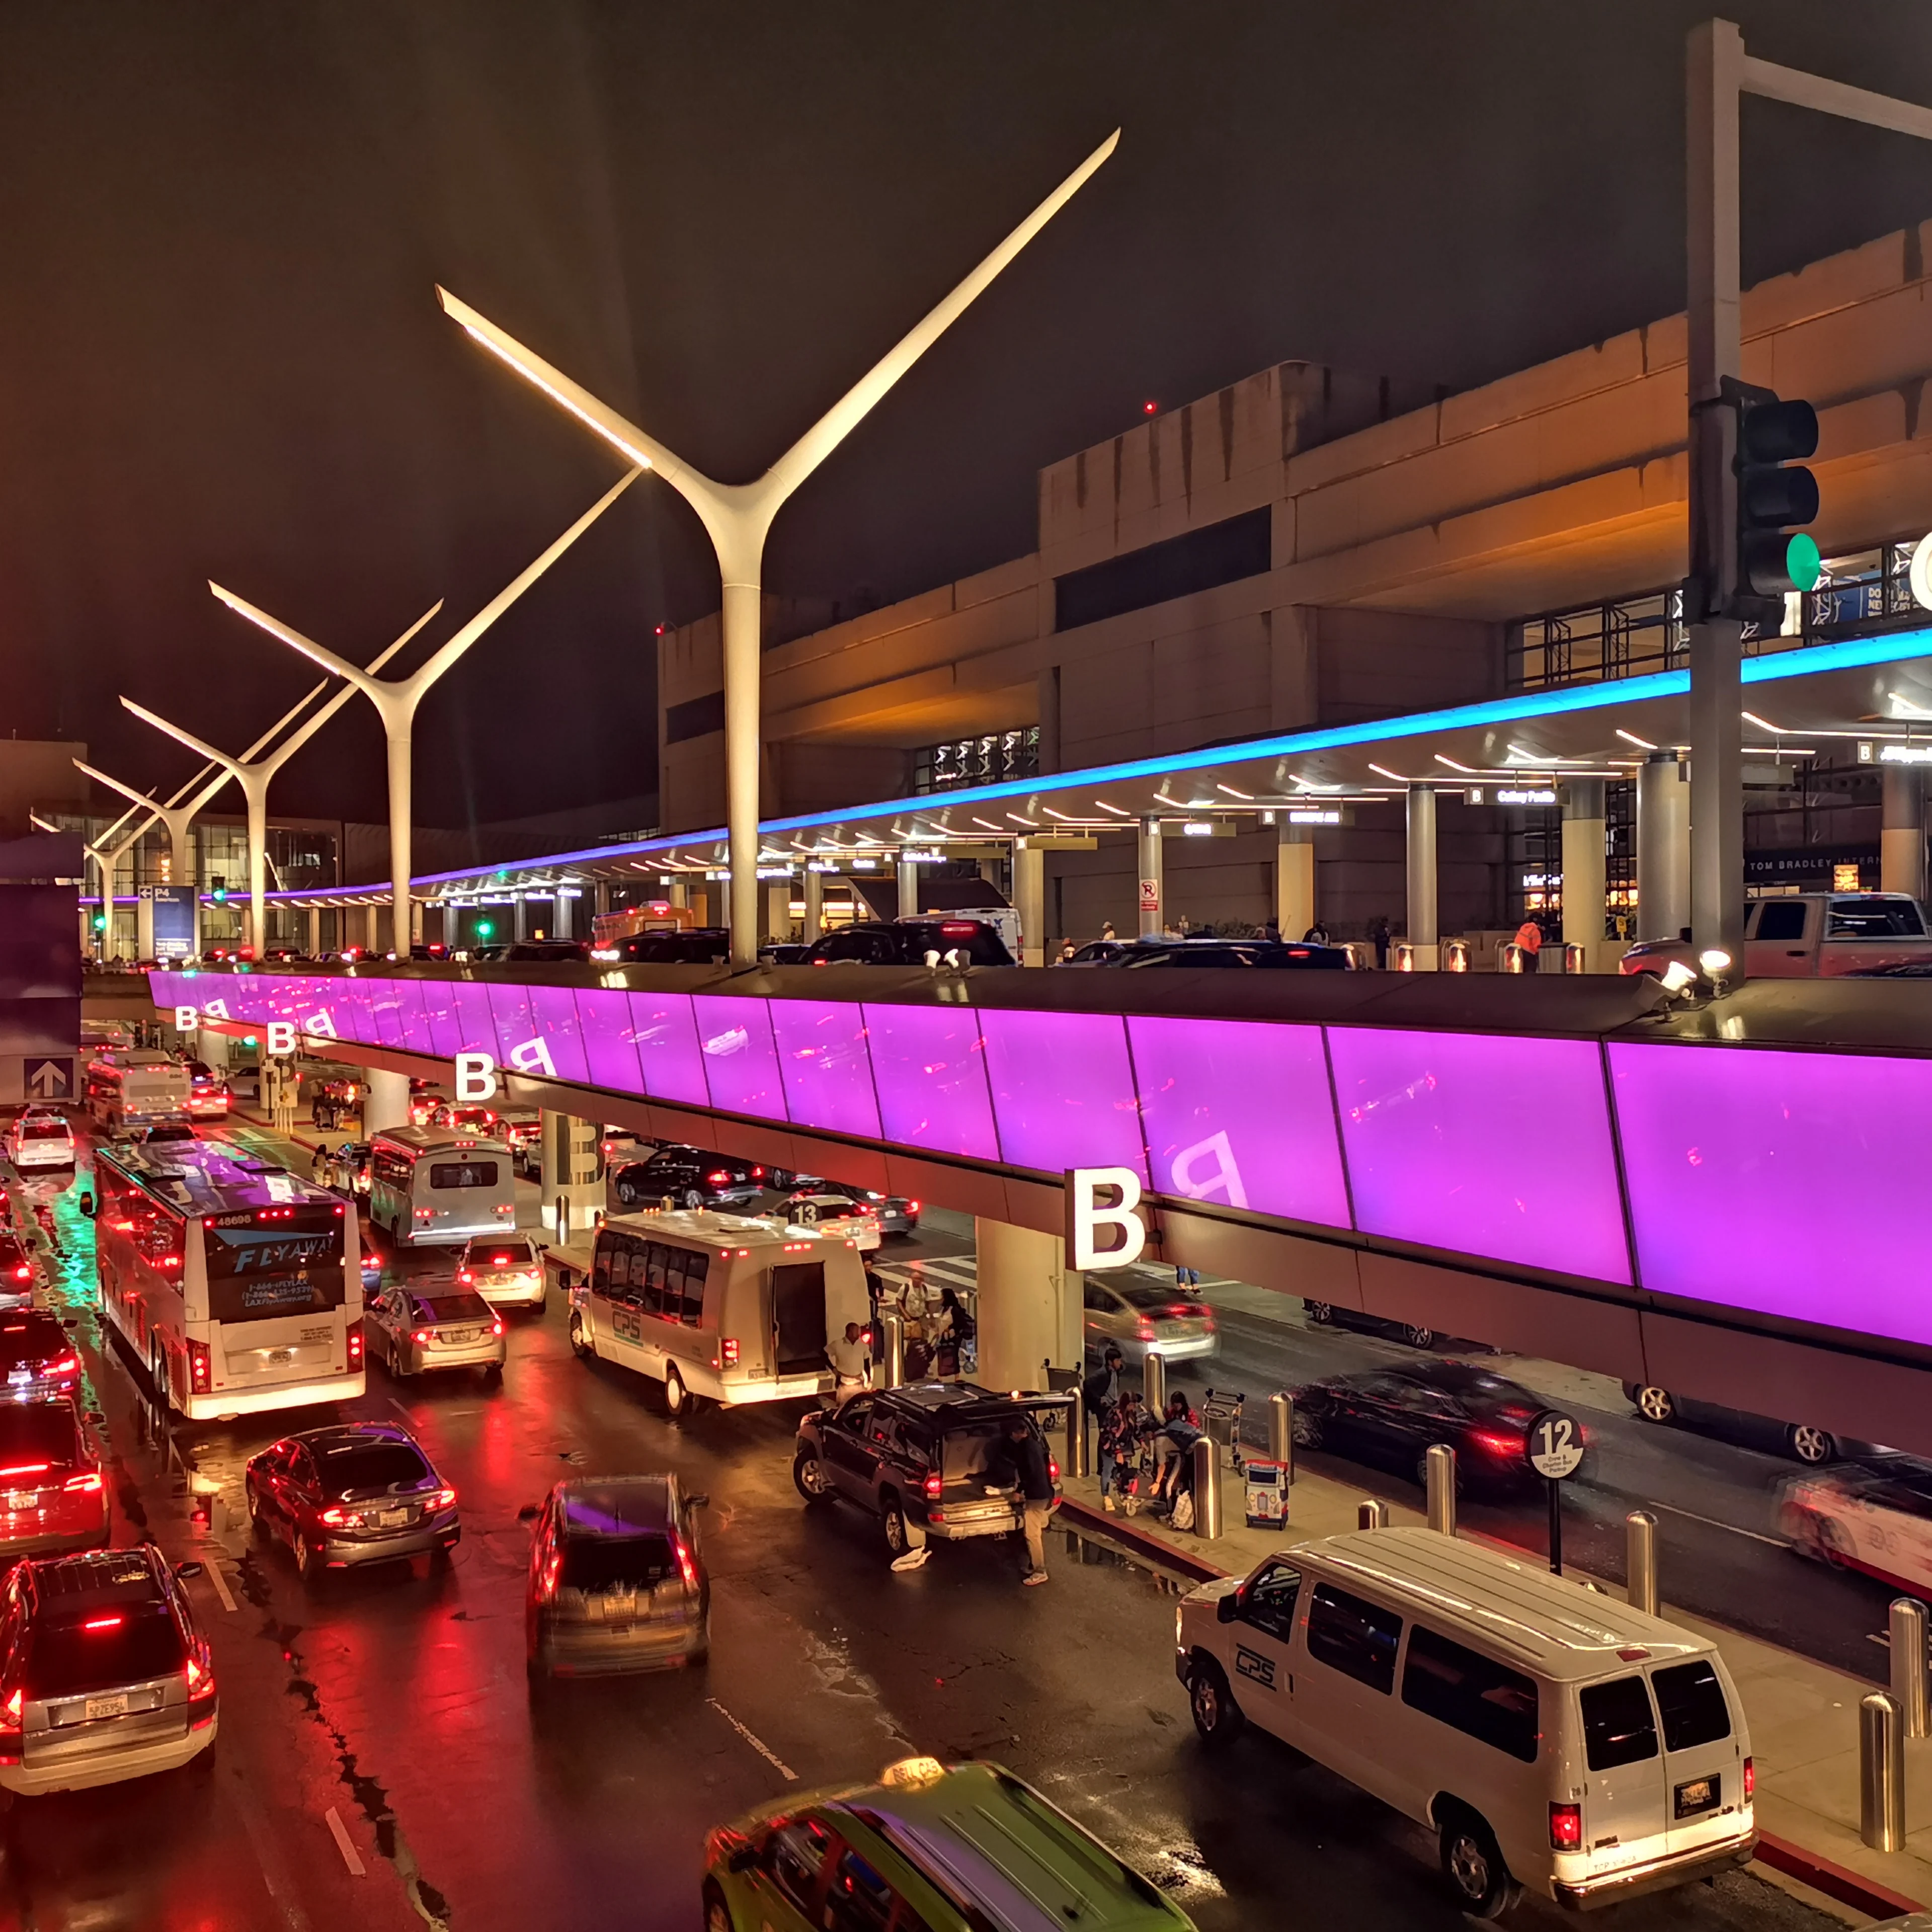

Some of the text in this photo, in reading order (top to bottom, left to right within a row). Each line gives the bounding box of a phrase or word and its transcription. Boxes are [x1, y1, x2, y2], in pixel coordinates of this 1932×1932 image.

[1750, 861, 1773, 871] TOM
[1779, 858, 1832, 870] BRADLEY
[154, 888, 170, 898] P4
[175, 1005, 198, 1031] B
[267, 1021, 296, 1055] B
[456, 1053, 497, 1101] B
[556, 1115, 605, 1185] B
[217, 1215, 251, 1226] 48698
[795, 1204, 817, 1224] 13
[1073, 1167, 1146, 1271] B
[612, 1310, 640, 1340] CPS
[1539, 1419, 1573, 1455] 12
[1236, 1650, 1275, 1683] CPS
